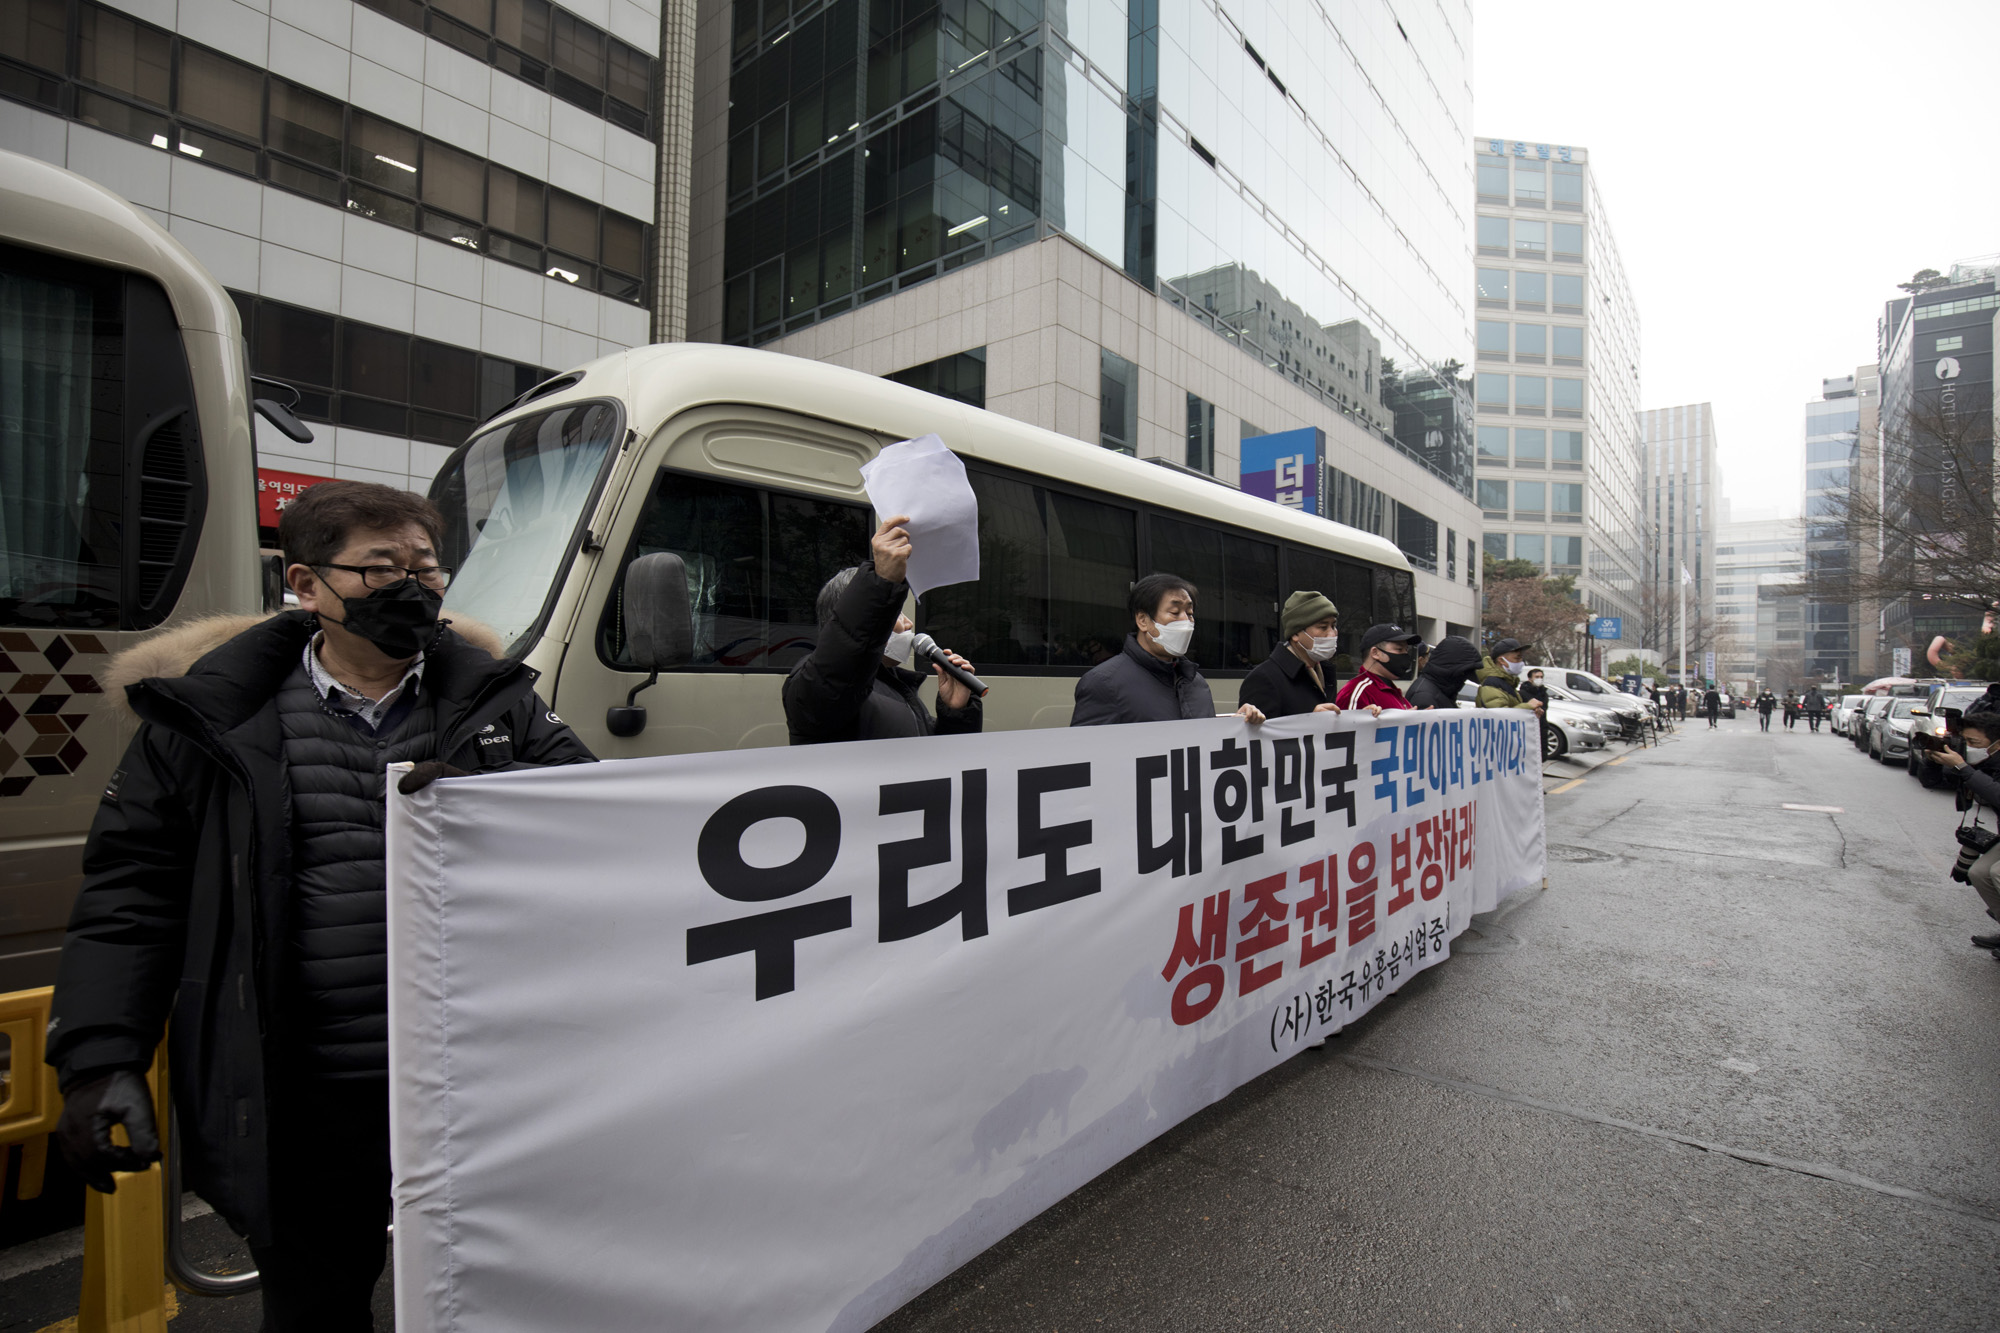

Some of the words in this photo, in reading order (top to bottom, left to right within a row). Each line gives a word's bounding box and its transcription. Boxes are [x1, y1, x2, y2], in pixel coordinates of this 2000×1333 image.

[1601, 619, 1613, 628] Sh
[479, 735, 510, 746] iDER
[686, 761, 1102, 1002] 우리도
[1136, 731, 1358, 878] 대한민국
[1371, 718, 1464, 813] 국민이며
[1469, 717, 1526, 785] 인간이다!
[1161, 841, 1379, 1026] 생존권을
[1388, 800, 1477, 917] 보장하라!
